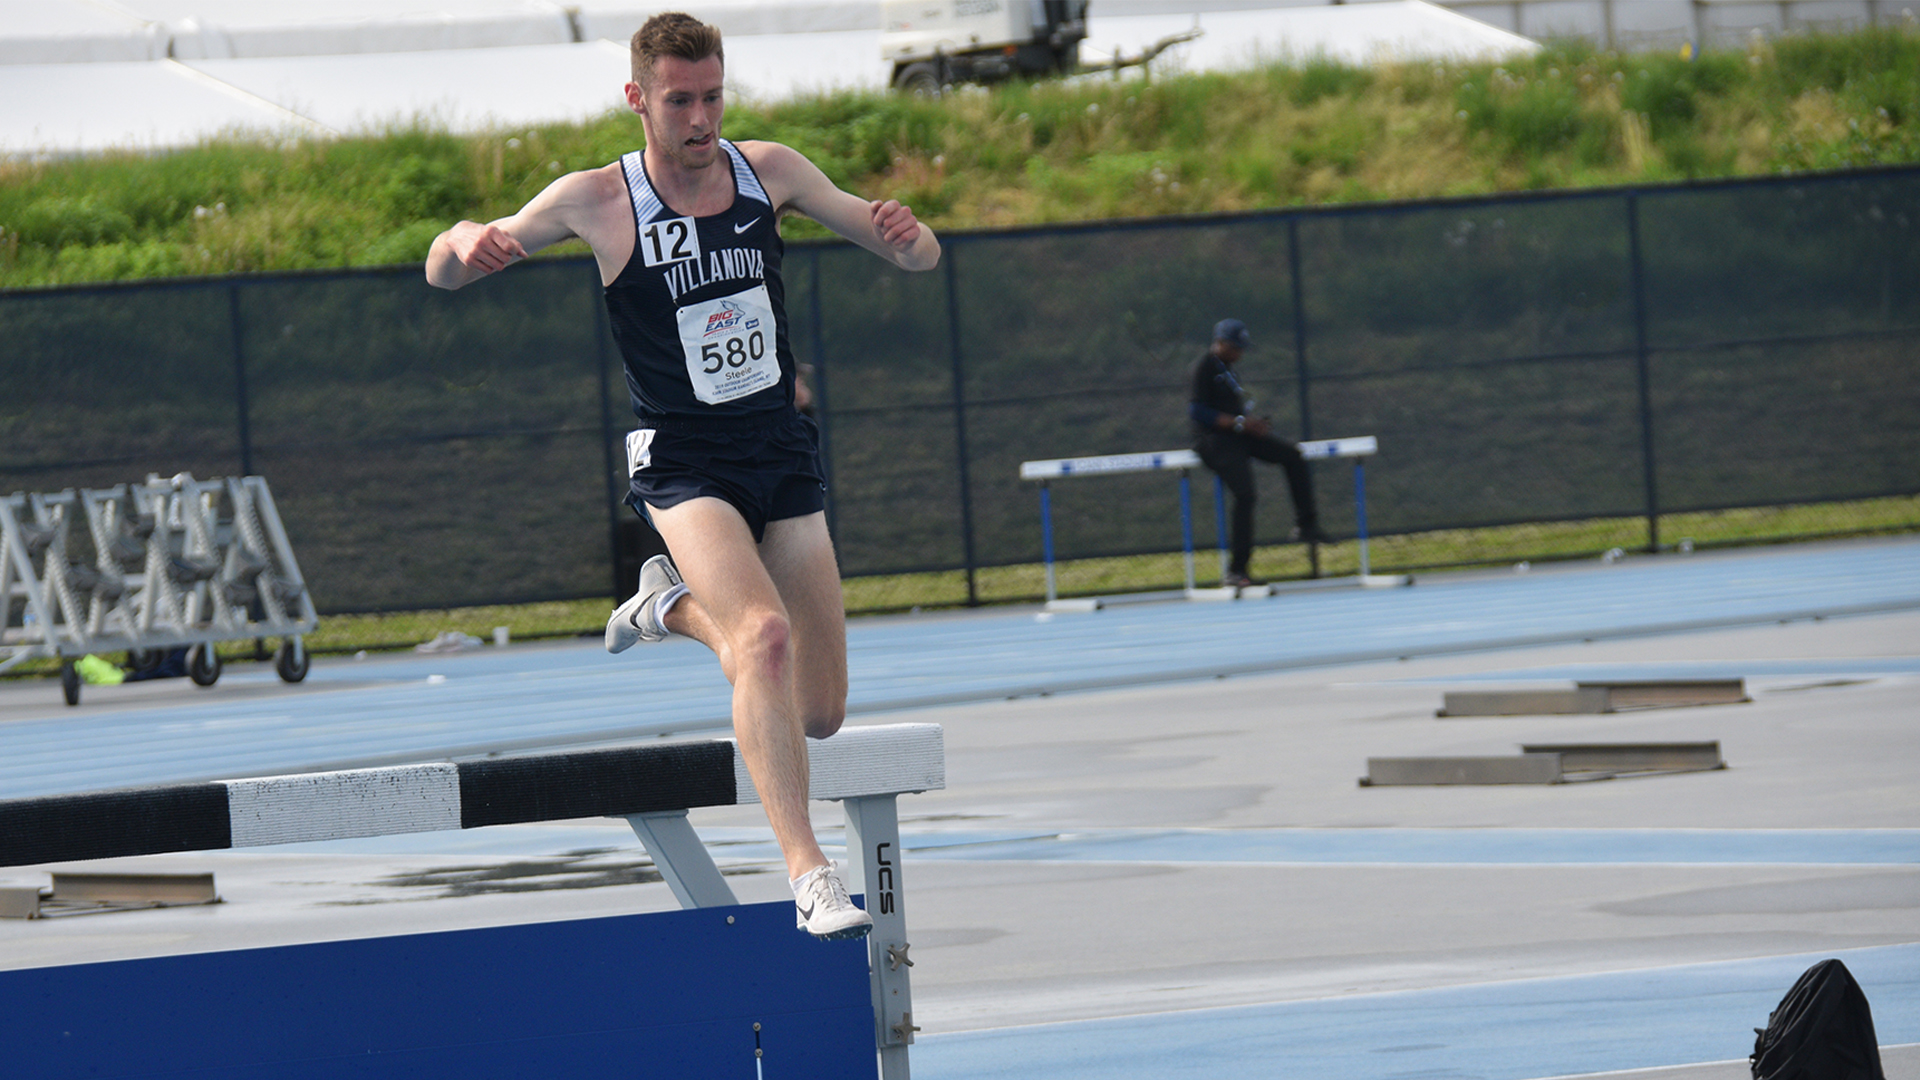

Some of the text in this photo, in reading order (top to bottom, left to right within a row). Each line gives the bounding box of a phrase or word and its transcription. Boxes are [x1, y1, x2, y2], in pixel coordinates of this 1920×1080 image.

[644, 220, 692, 263] 12
[663, 248, 765, 300] VILLANOVA
[705, 317, 742, 332] EAST
[708, 309, 734, 324] BIG
[701, 330, 764, 374] 580
[725, 366, 753, 381] Steele
[877, 842, 895, 915] UCS
